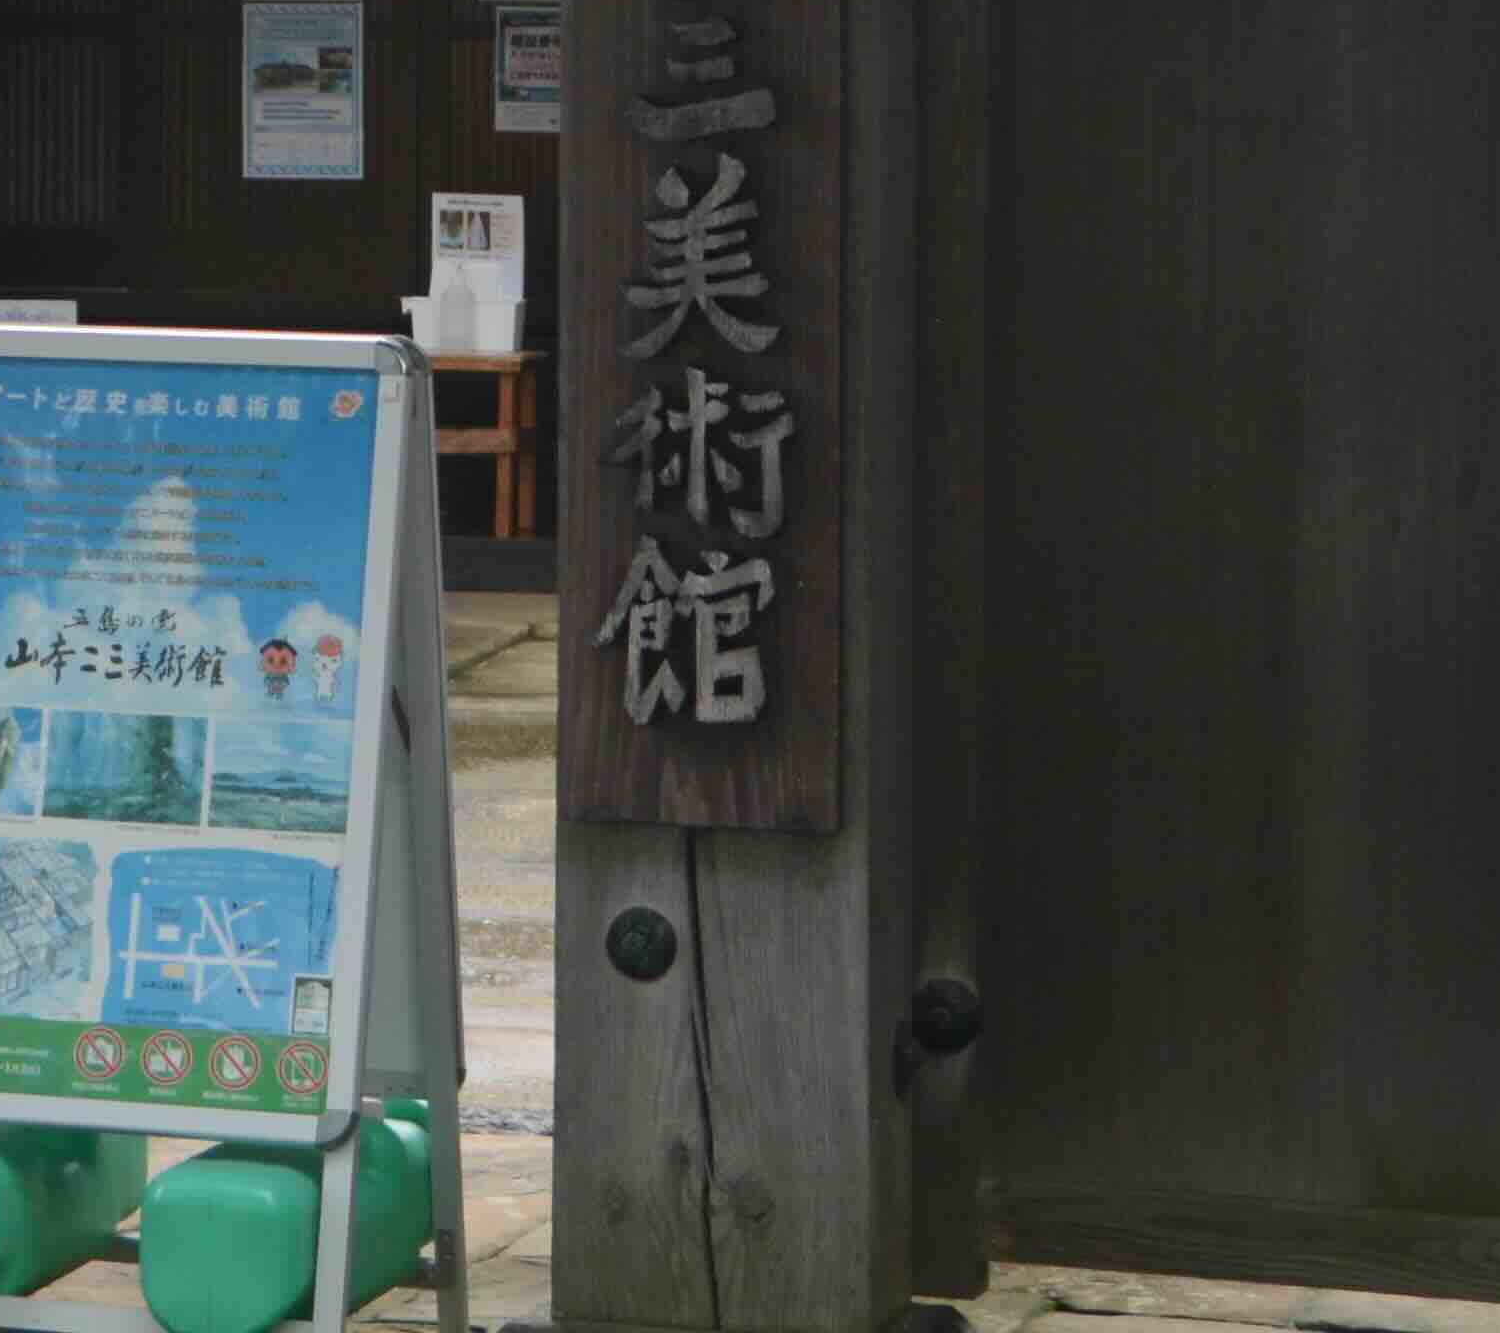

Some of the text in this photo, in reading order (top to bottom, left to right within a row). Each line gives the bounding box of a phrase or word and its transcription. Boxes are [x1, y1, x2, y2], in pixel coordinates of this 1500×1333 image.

[4, 631, 228, 687] 山本二三美術館
